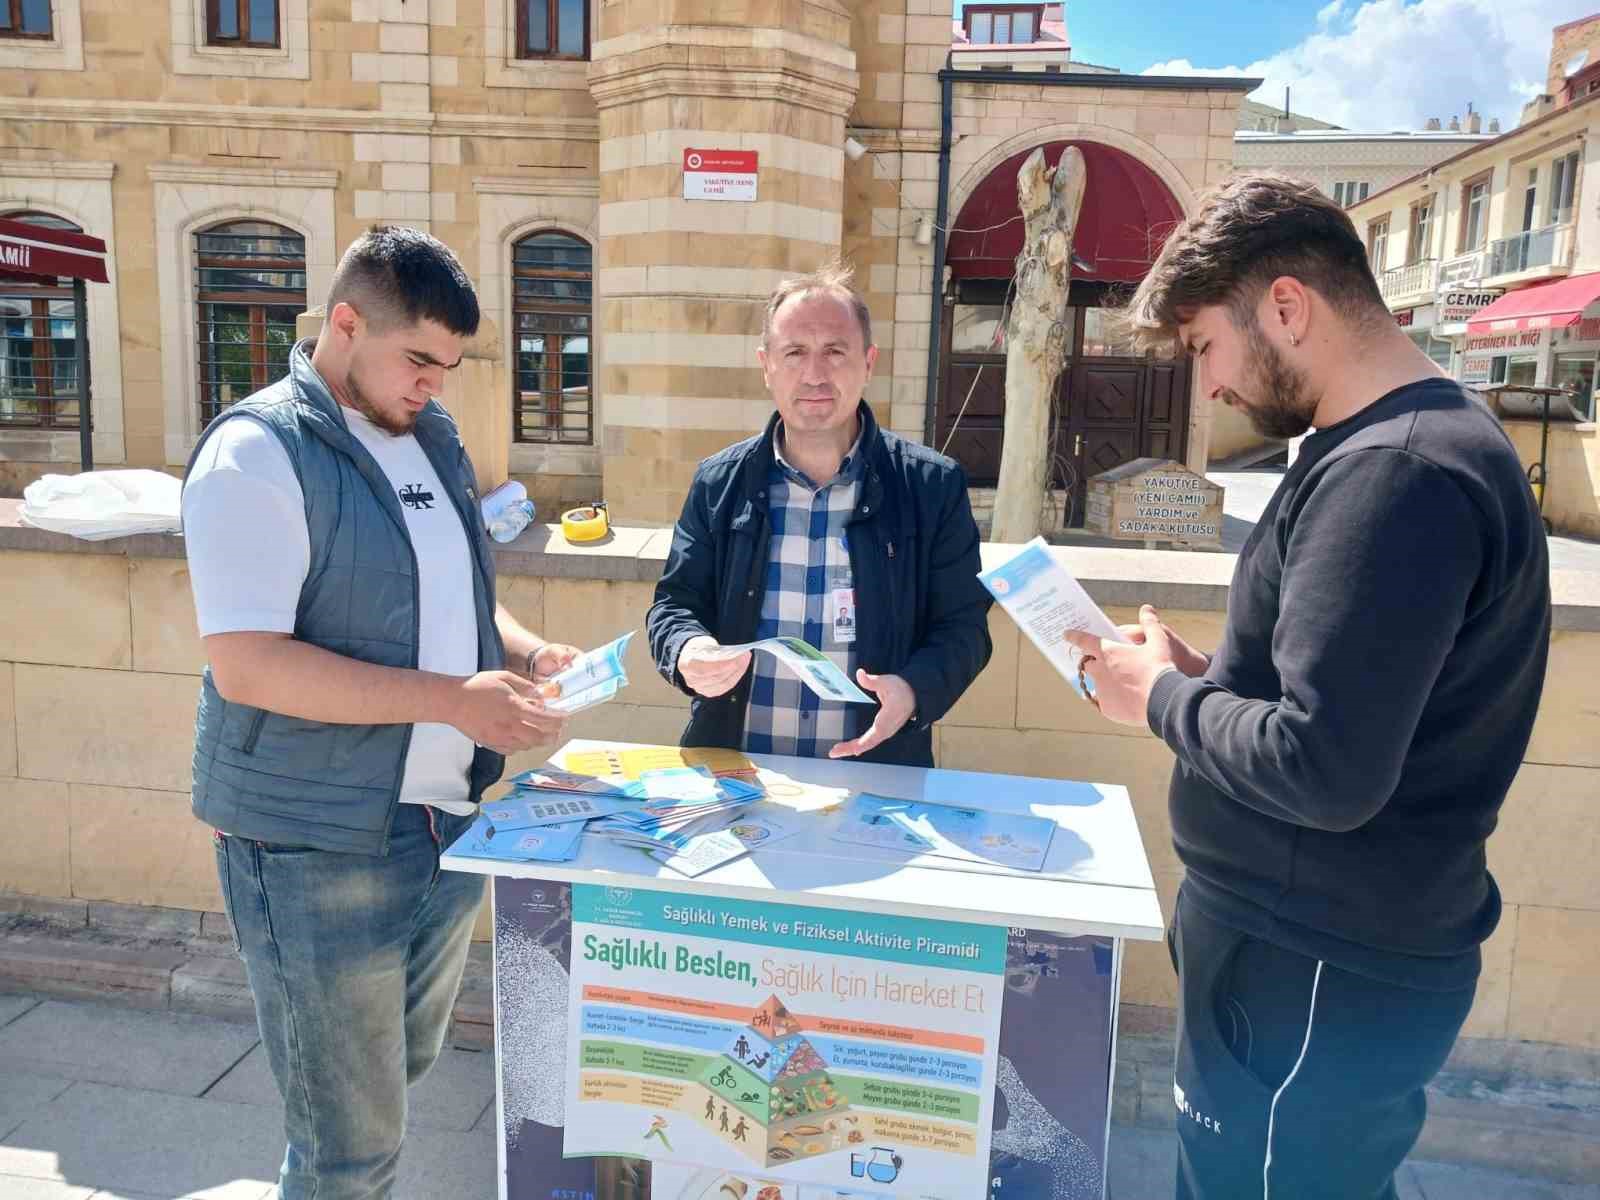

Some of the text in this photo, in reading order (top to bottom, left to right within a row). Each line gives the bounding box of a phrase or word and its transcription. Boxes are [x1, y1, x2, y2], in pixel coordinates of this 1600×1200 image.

[1119, 520, 1216, 535] SADAKA KUTUSU
[1138, 507, 1199, 520] YARDIM ve
[663, 904, 716, 926] Sağlıklı
[720, 911, 769, 932] Yemek
[773, 921, 788, 934] ve
[794, 920, 850, 942] Fiziksel
[854, 928, 912, 951] Aktivite
[916, 936, 981, 960] Piramidi
[583, 934, 668, 972] Sağlıklı
[675, 945, 758, 988] Beslen,
[760, 958, 825, 997] Sağlık
[874, 970, 957, 1009] Hareket
[964, 983, 985, 1014] Et
